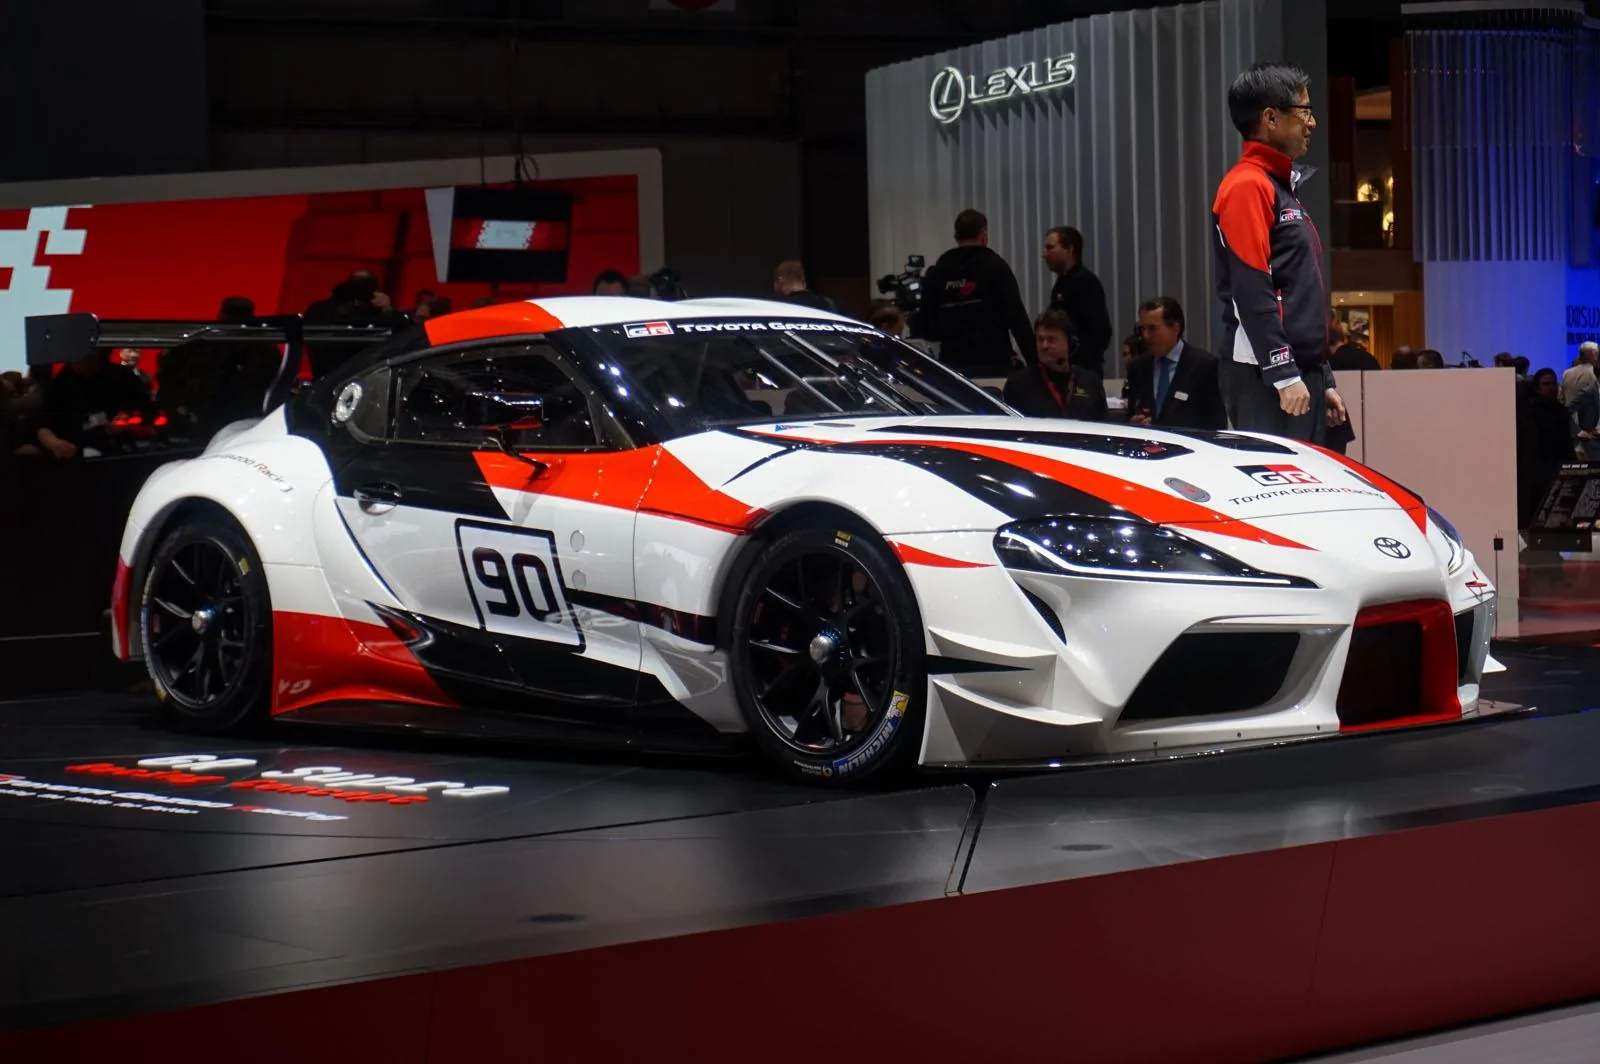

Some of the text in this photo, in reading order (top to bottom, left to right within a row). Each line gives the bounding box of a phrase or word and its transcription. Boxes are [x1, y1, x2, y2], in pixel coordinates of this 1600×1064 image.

[967, 52, 1076, 104] LEXUS
[627, 323, 672, 337] GR
[676, 322, 768, 333] TOYOTA
[768, 322, 835, 332] GAZOO
[1270, 350, 1290, 364] GR
[1246, 469, 1323, 486] GR
[1228, 490, 1290, 505] TOYOTA
[1291, 487, 1341, 495] GAZOO
[472, 546, 563, 624] 90
[838, 721, 894, 774] MICHELIN
